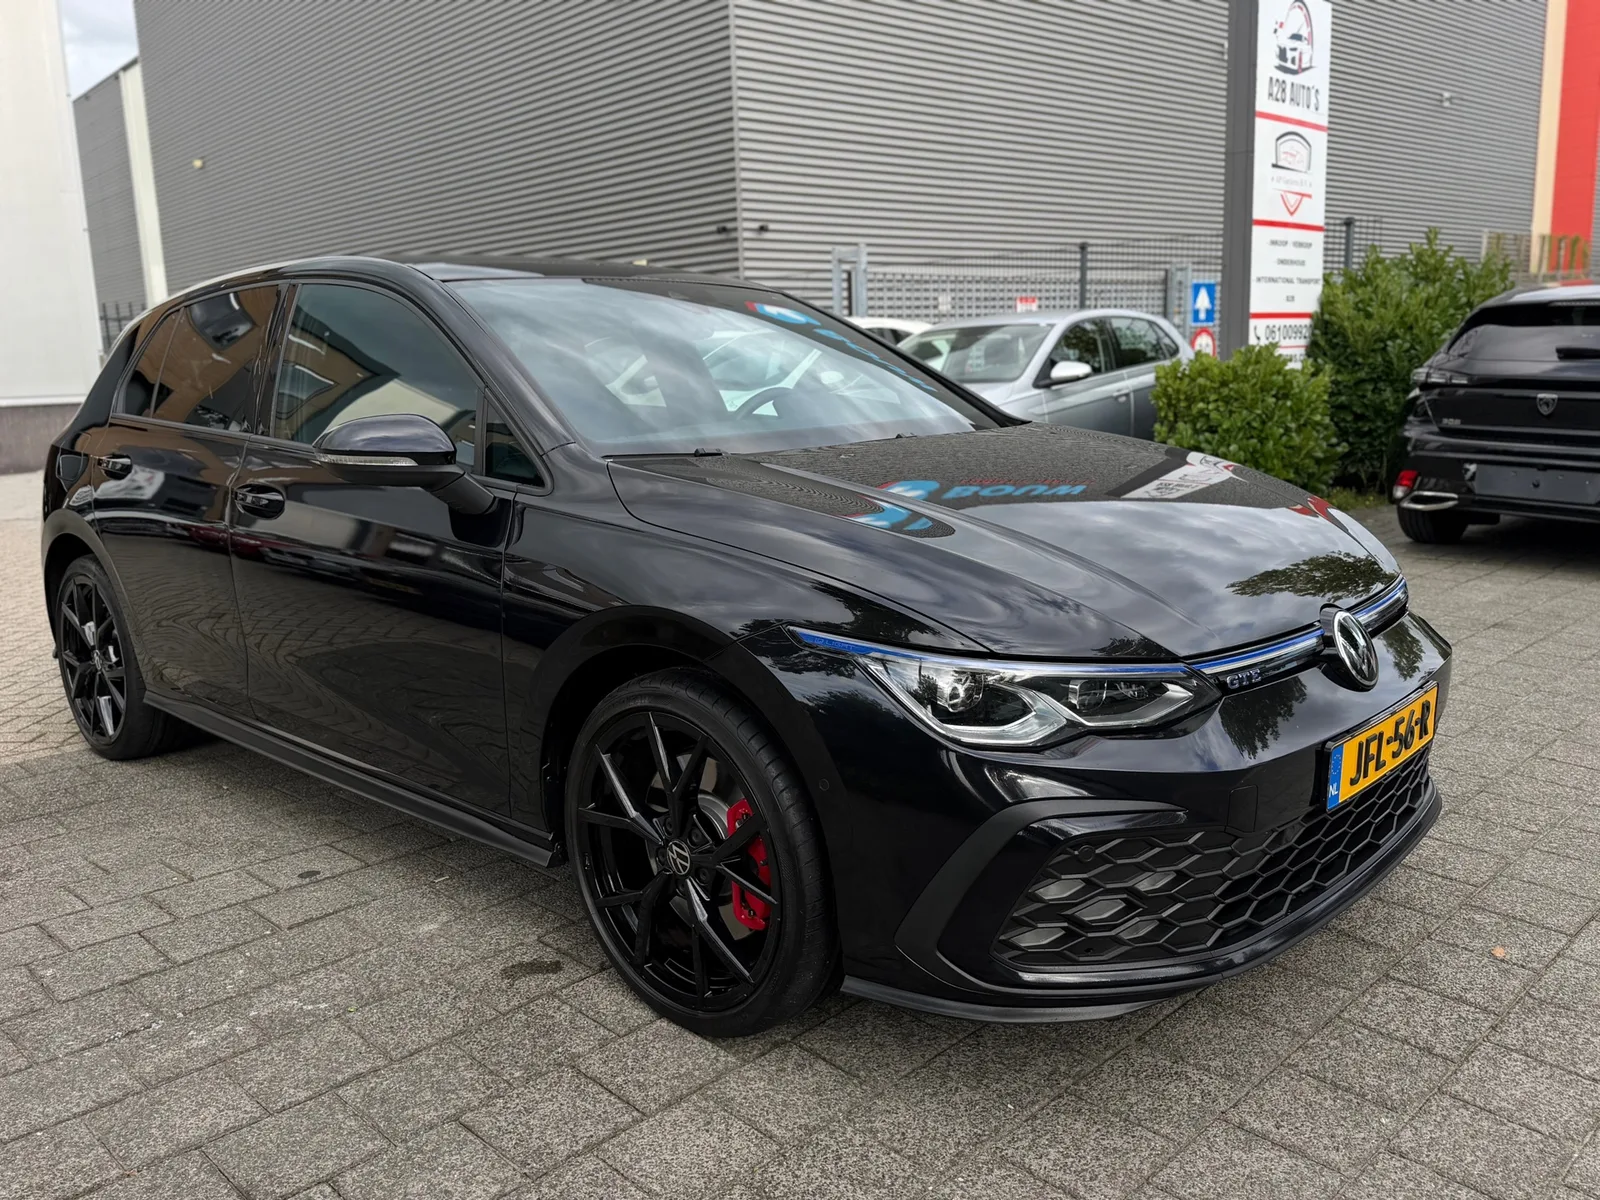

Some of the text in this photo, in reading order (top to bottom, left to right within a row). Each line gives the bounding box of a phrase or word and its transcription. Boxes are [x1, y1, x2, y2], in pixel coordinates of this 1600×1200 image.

[1268, 76, 1287, 103] A28
[1350, 700, 1431, 786] JFL-56-R
[1329, 783, 1338, 797] NL
